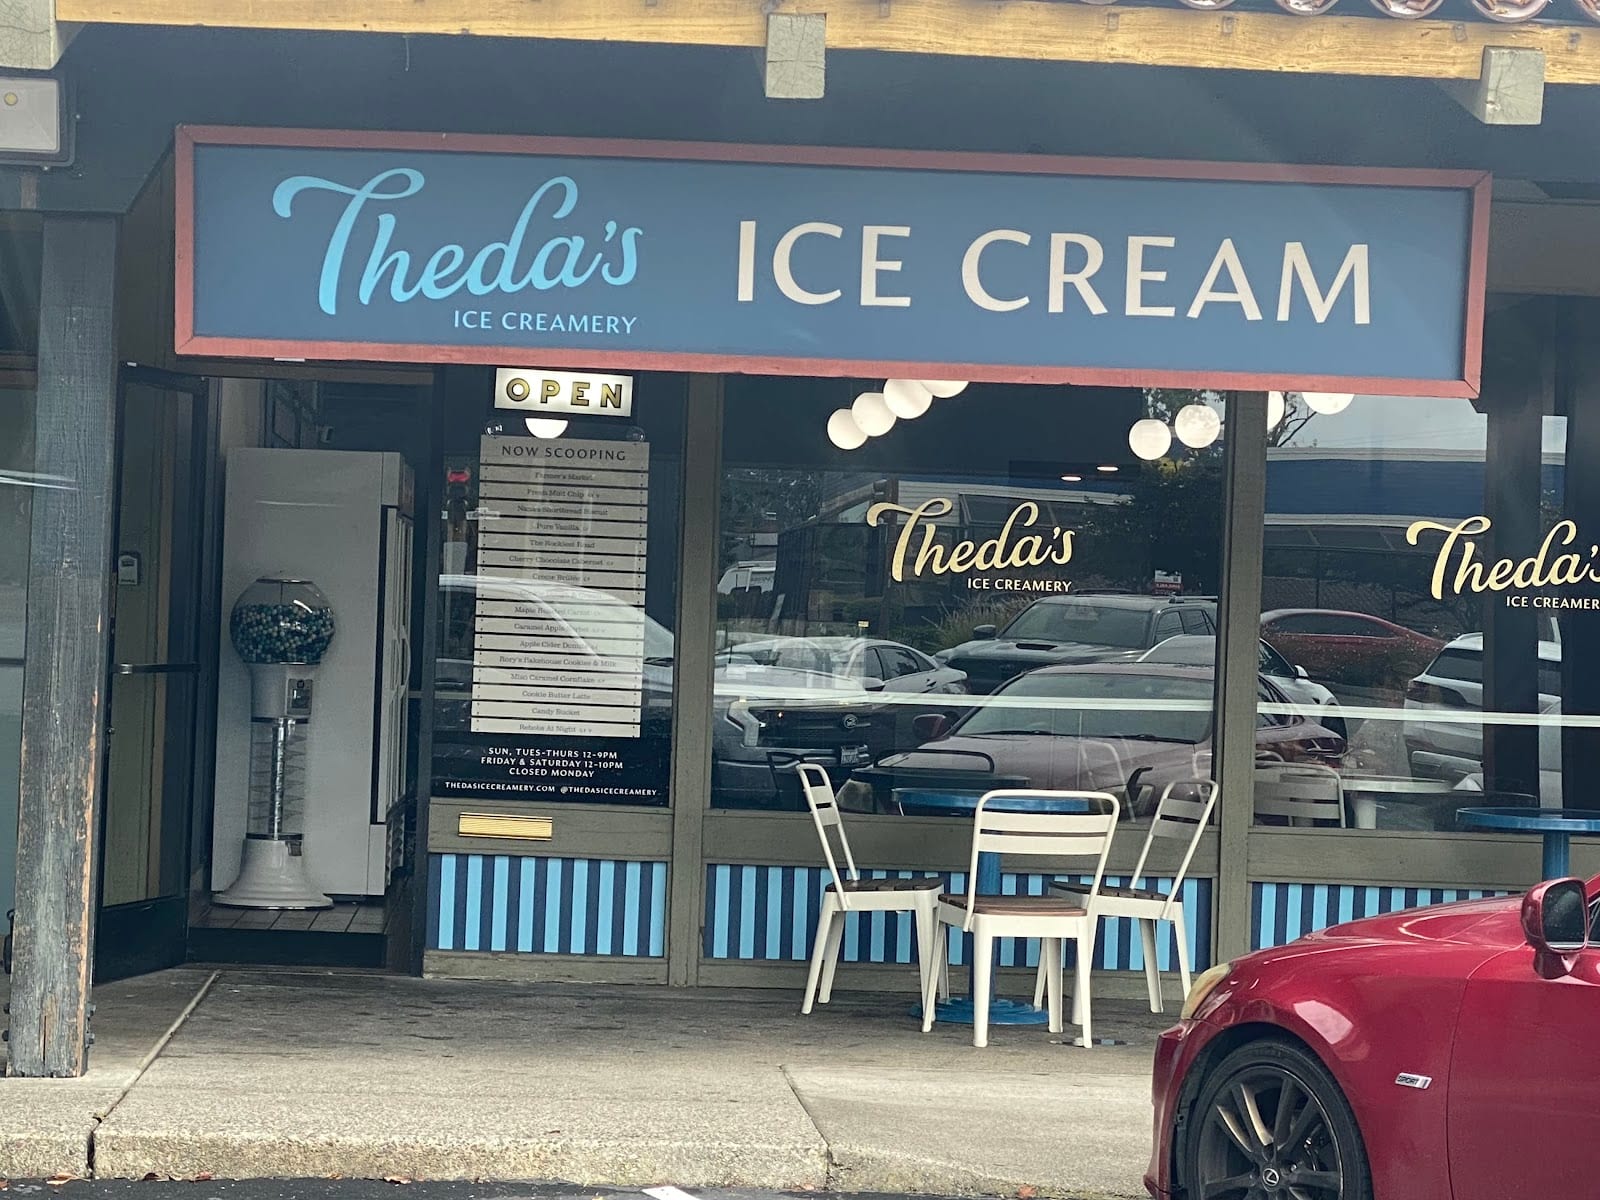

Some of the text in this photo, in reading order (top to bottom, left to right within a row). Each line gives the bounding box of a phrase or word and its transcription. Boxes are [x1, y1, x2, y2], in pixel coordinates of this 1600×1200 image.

[272, 167, 643, 315] Theda's
[737, 220, 1370, 325] ICE CREAM
[454, 310, 638, 334] ICE CREAMERY
[506, 377, 623, 409] OPEN
[502, 445, 626, 461] NOW SCOOPING
[549, 489, 566, 497] Mint
[567, 490, 584, 499] Chip
[866, 497, 1076, 582] Theda's
[508, 555, 533, 564] Cherry
[535, 556, 570, 564] Chocolate
[967, 577, 1072, 592] ICE CREAMERY
[1506, 595, 1528, 608] ICE
[514, 606, 535, 615] Maple
[537, 607, 565, 615] Roted
[513, 623, 543, 631] Caramel
[544, 624, 565, 633] Apple
[520, 640, 540, 649] Apple
[541, 640, 560, 648] Cider
[500, 655, 522, 664] Rory's
[563, 658, 591, 666] Cookies
[593, 659, 599, 667] &
[600, 660, 617, 668] Milk
[510, 673, 528, 681] Miso
[529, 674, 559, 682] Caramel
[560, 675, 595, 684] Cornflake
[522, 690, 591, 700] Cookie Butter Latte
[531, 707, 554, 717] Candy
[556, 725, 576, 735] Night
[488, 747, 618, 760] SUN, TUES-THURS 12-9PM
[481, 756, 624, 769] FRIDAY & SATURDAY 12-10PM
[509, 767, 595, 778] CLOSED MONDAY
[445, 781, 658, 796] THEDASICECREAMERY.COM @THEDASICECREAMERY
[1397, 1075, 1420, 1086] SPORT
